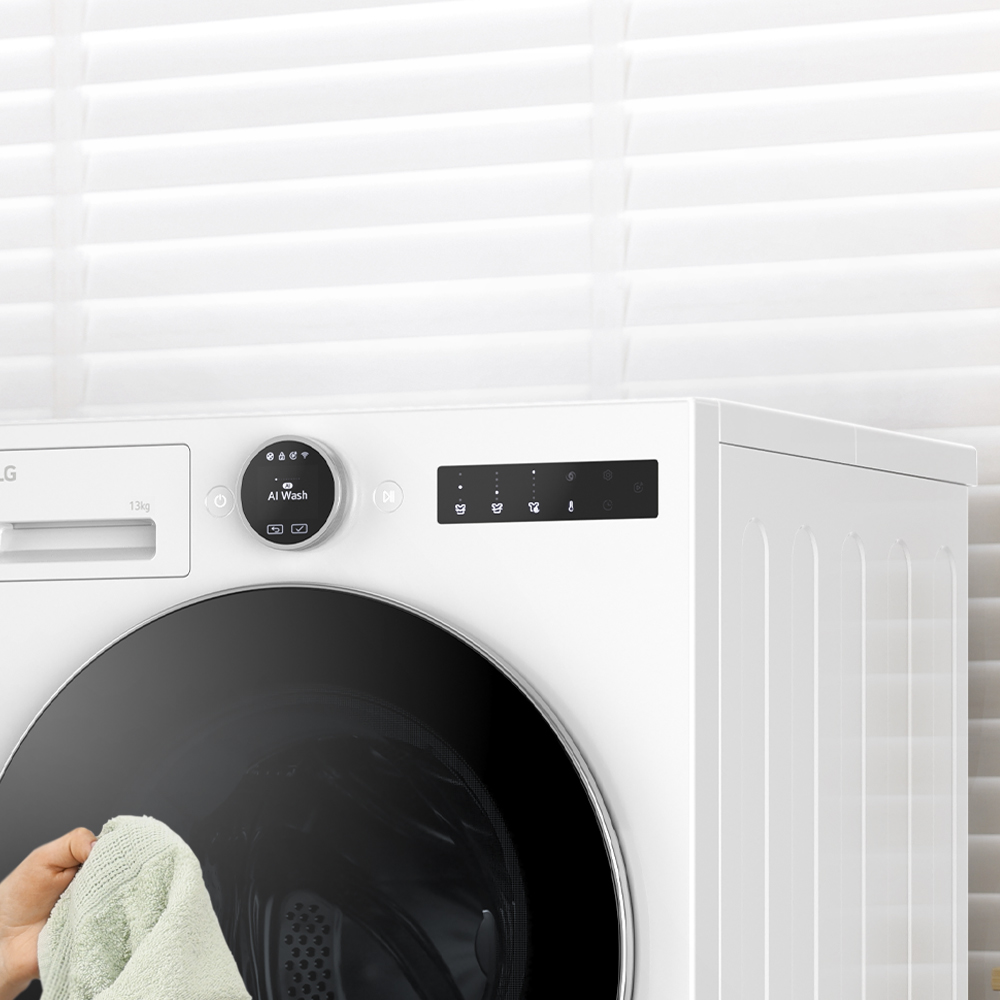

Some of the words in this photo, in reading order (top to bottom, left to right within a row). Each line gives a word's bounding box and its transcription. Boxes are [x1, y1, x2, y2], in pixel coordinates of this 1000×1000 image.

[267, 491, 279, 501] AI
[281, 490, 308, 501] Wash
[129, 501, 150, 513] 13kg
